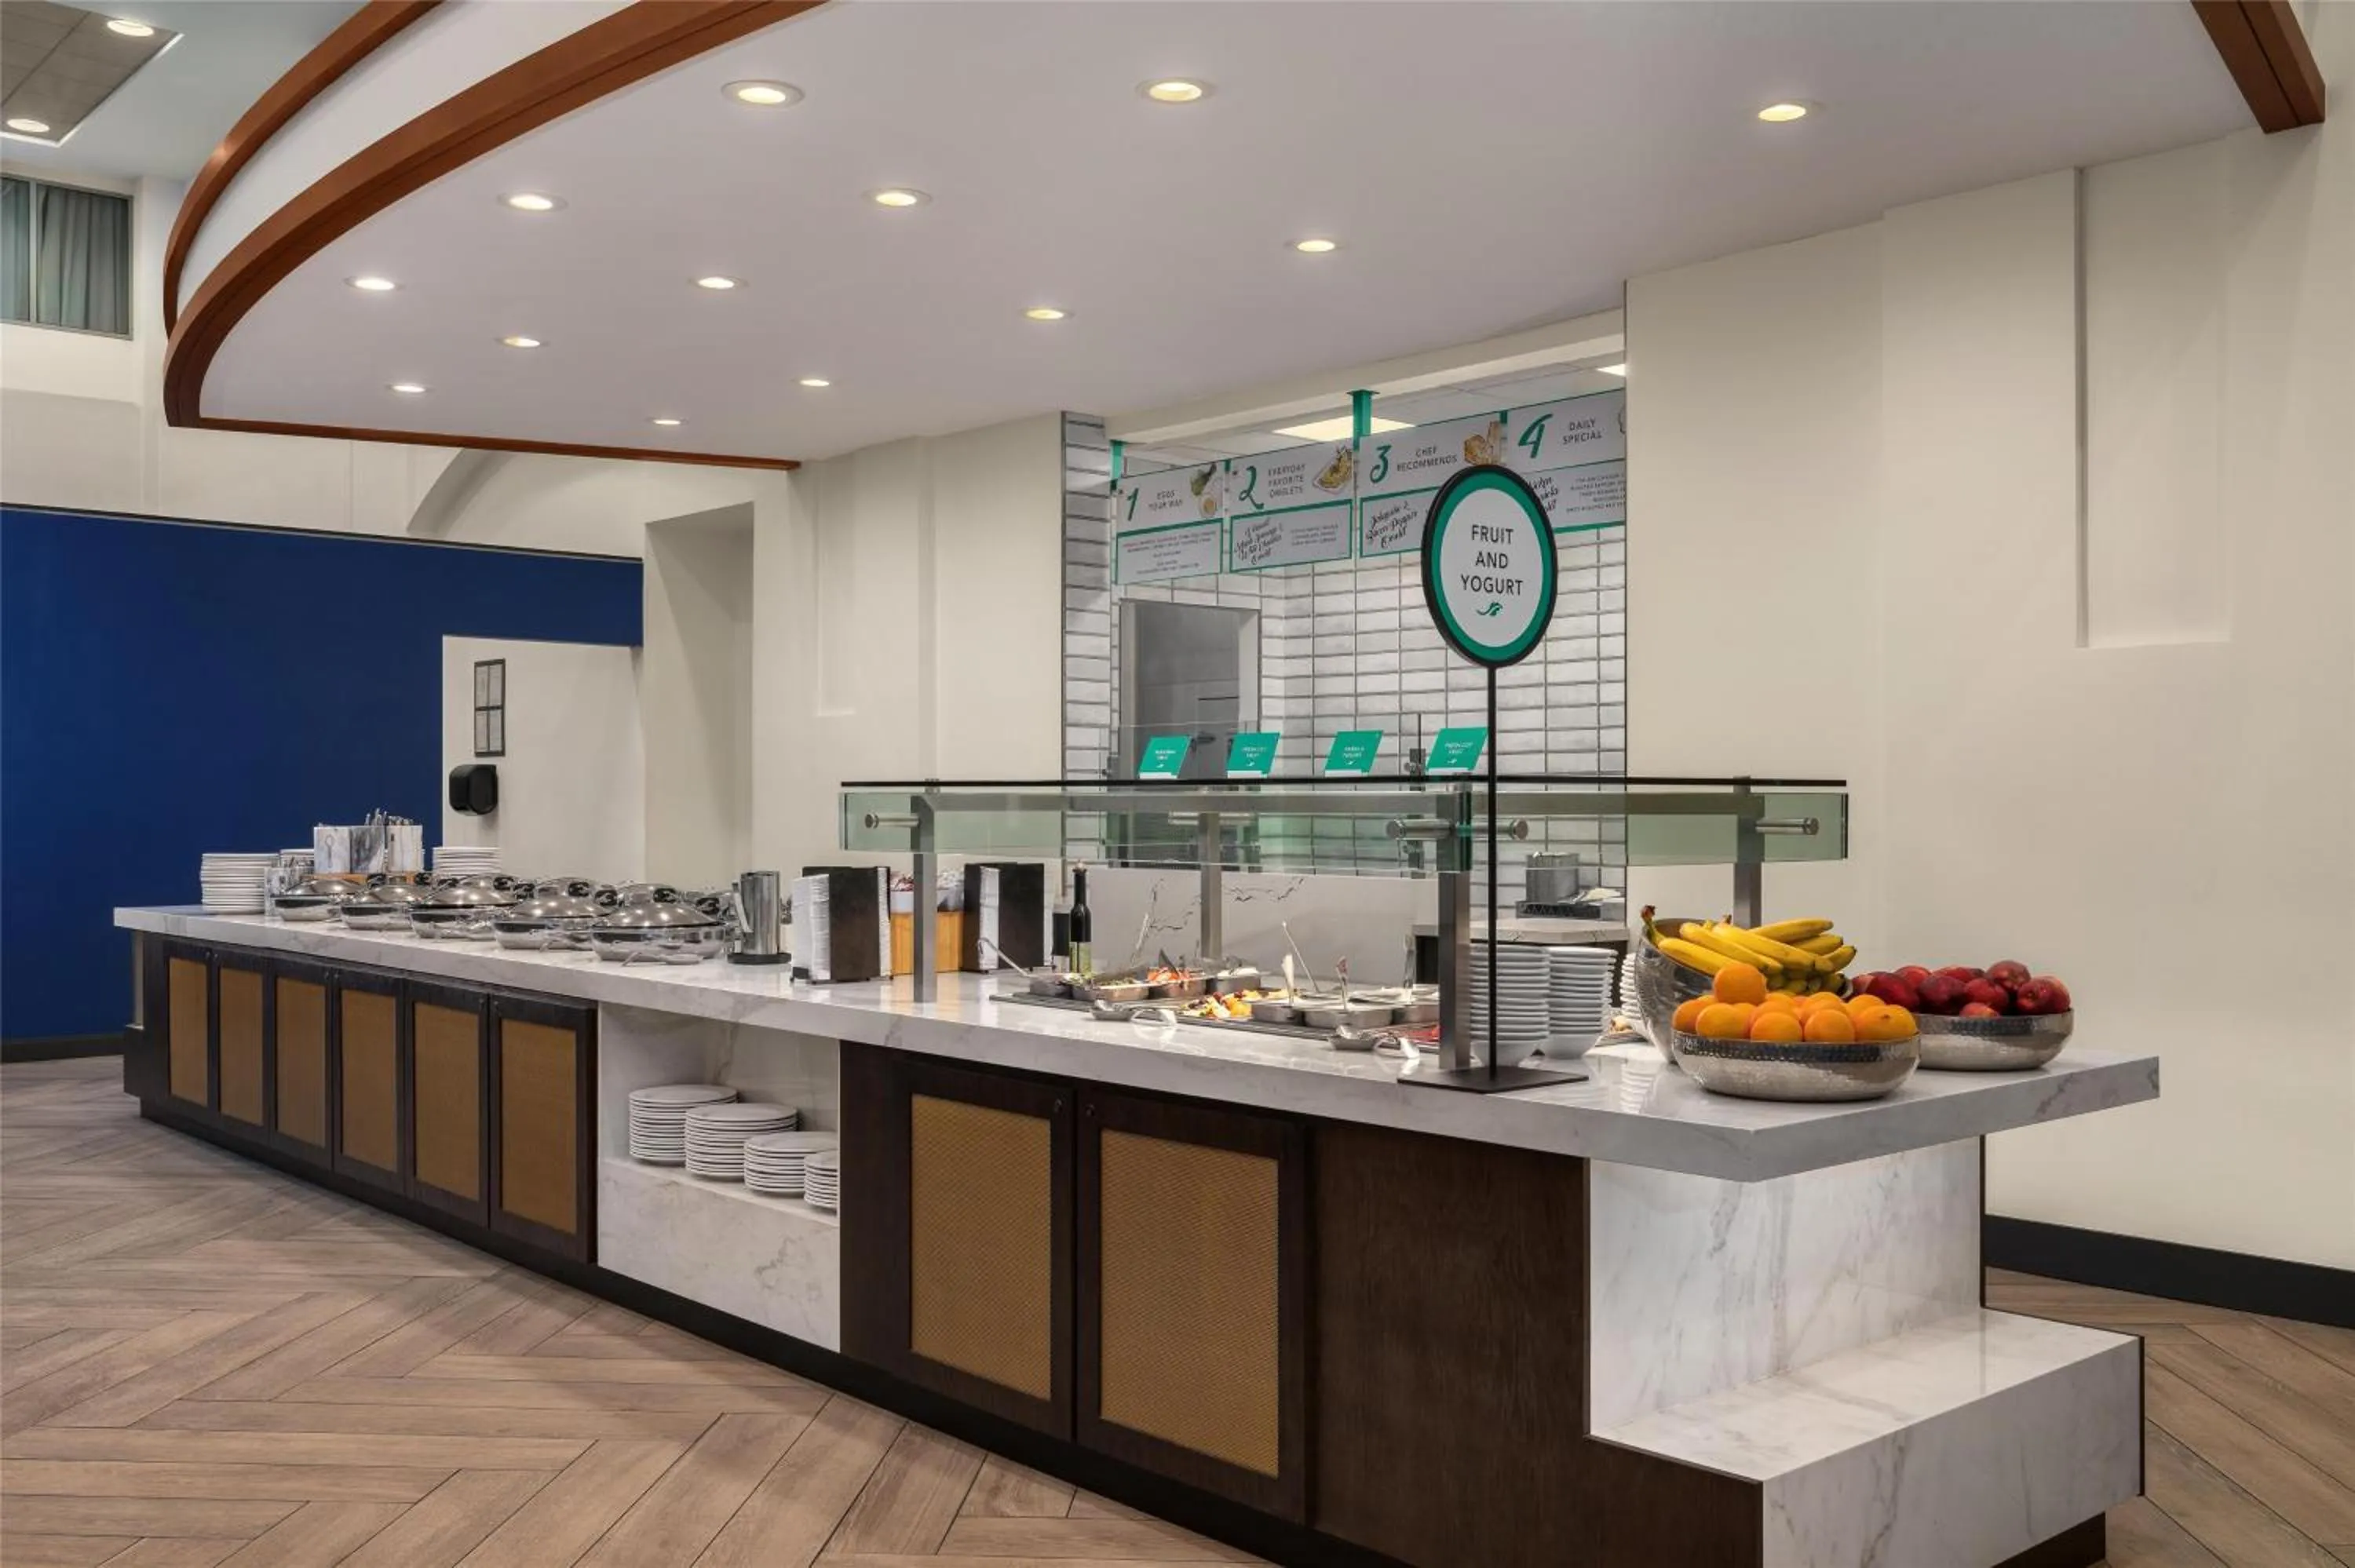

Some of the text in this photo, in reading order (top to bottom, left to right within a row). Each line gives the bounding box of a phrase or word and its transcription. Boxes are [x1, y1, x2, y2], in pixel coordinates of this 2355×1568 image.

[1570, 418, 1597, 432] DAILY
[1517, 414, 1554, 459] 4
[1563, 431, 1603, 445] SPECIAL
[1268, 464, 1306, 476] EVERYDAY
[1370, 444, 1393, 483] 3
[1397, 454, 1458, 472] RECOMMENDS
[1238, 465, 1265, 509] 2
[1268, 474, 1304, 487] FAVORITE
[1126, 487, 1139, 521] 1
[1471, 524, 1514, 545] FRUIT
[1475, 550, 1509, 569] AND
[1460, 573, 1524, 596] YOGURT
